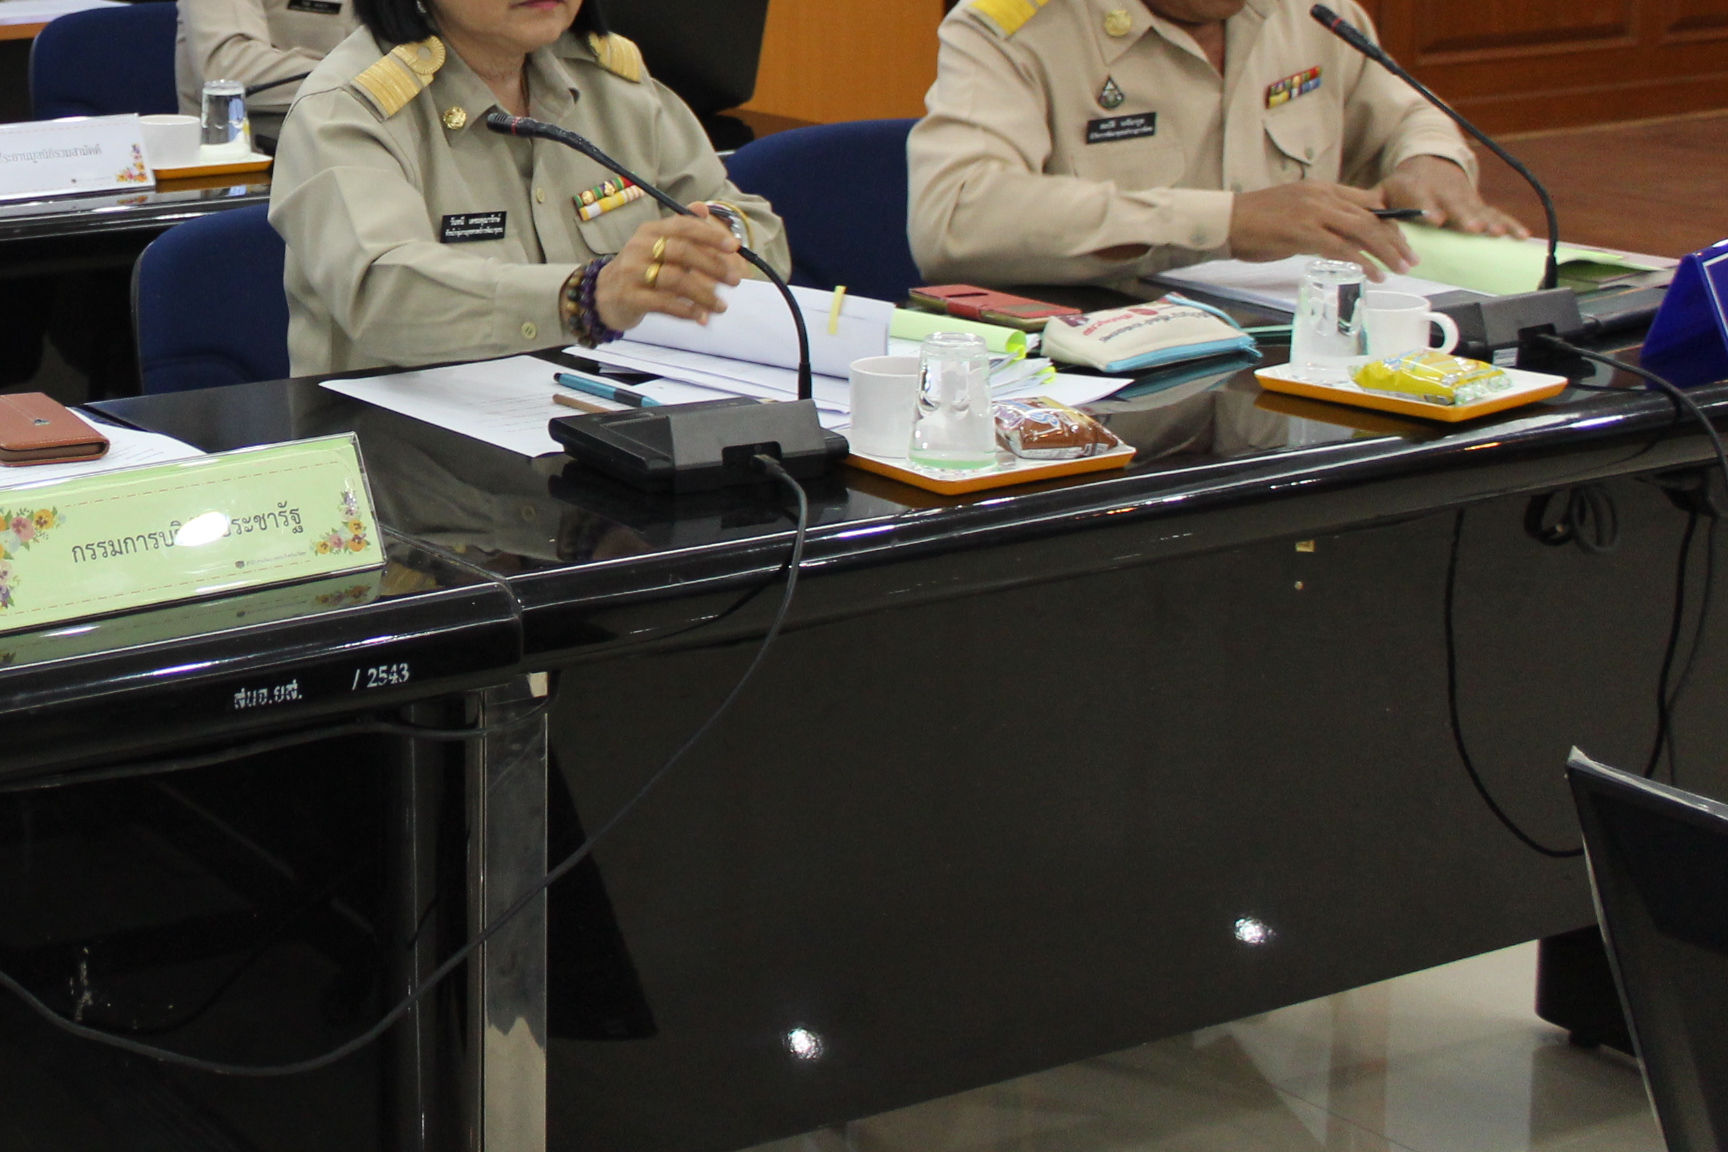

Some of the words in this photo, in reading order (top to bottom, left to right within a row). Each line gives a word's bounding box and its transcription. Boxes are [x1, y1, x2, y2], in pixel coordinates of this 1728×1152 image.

[71, 500, 304, 563] กรรมการบิระชารัฐ
[366, 663, 410, 688] 2543
